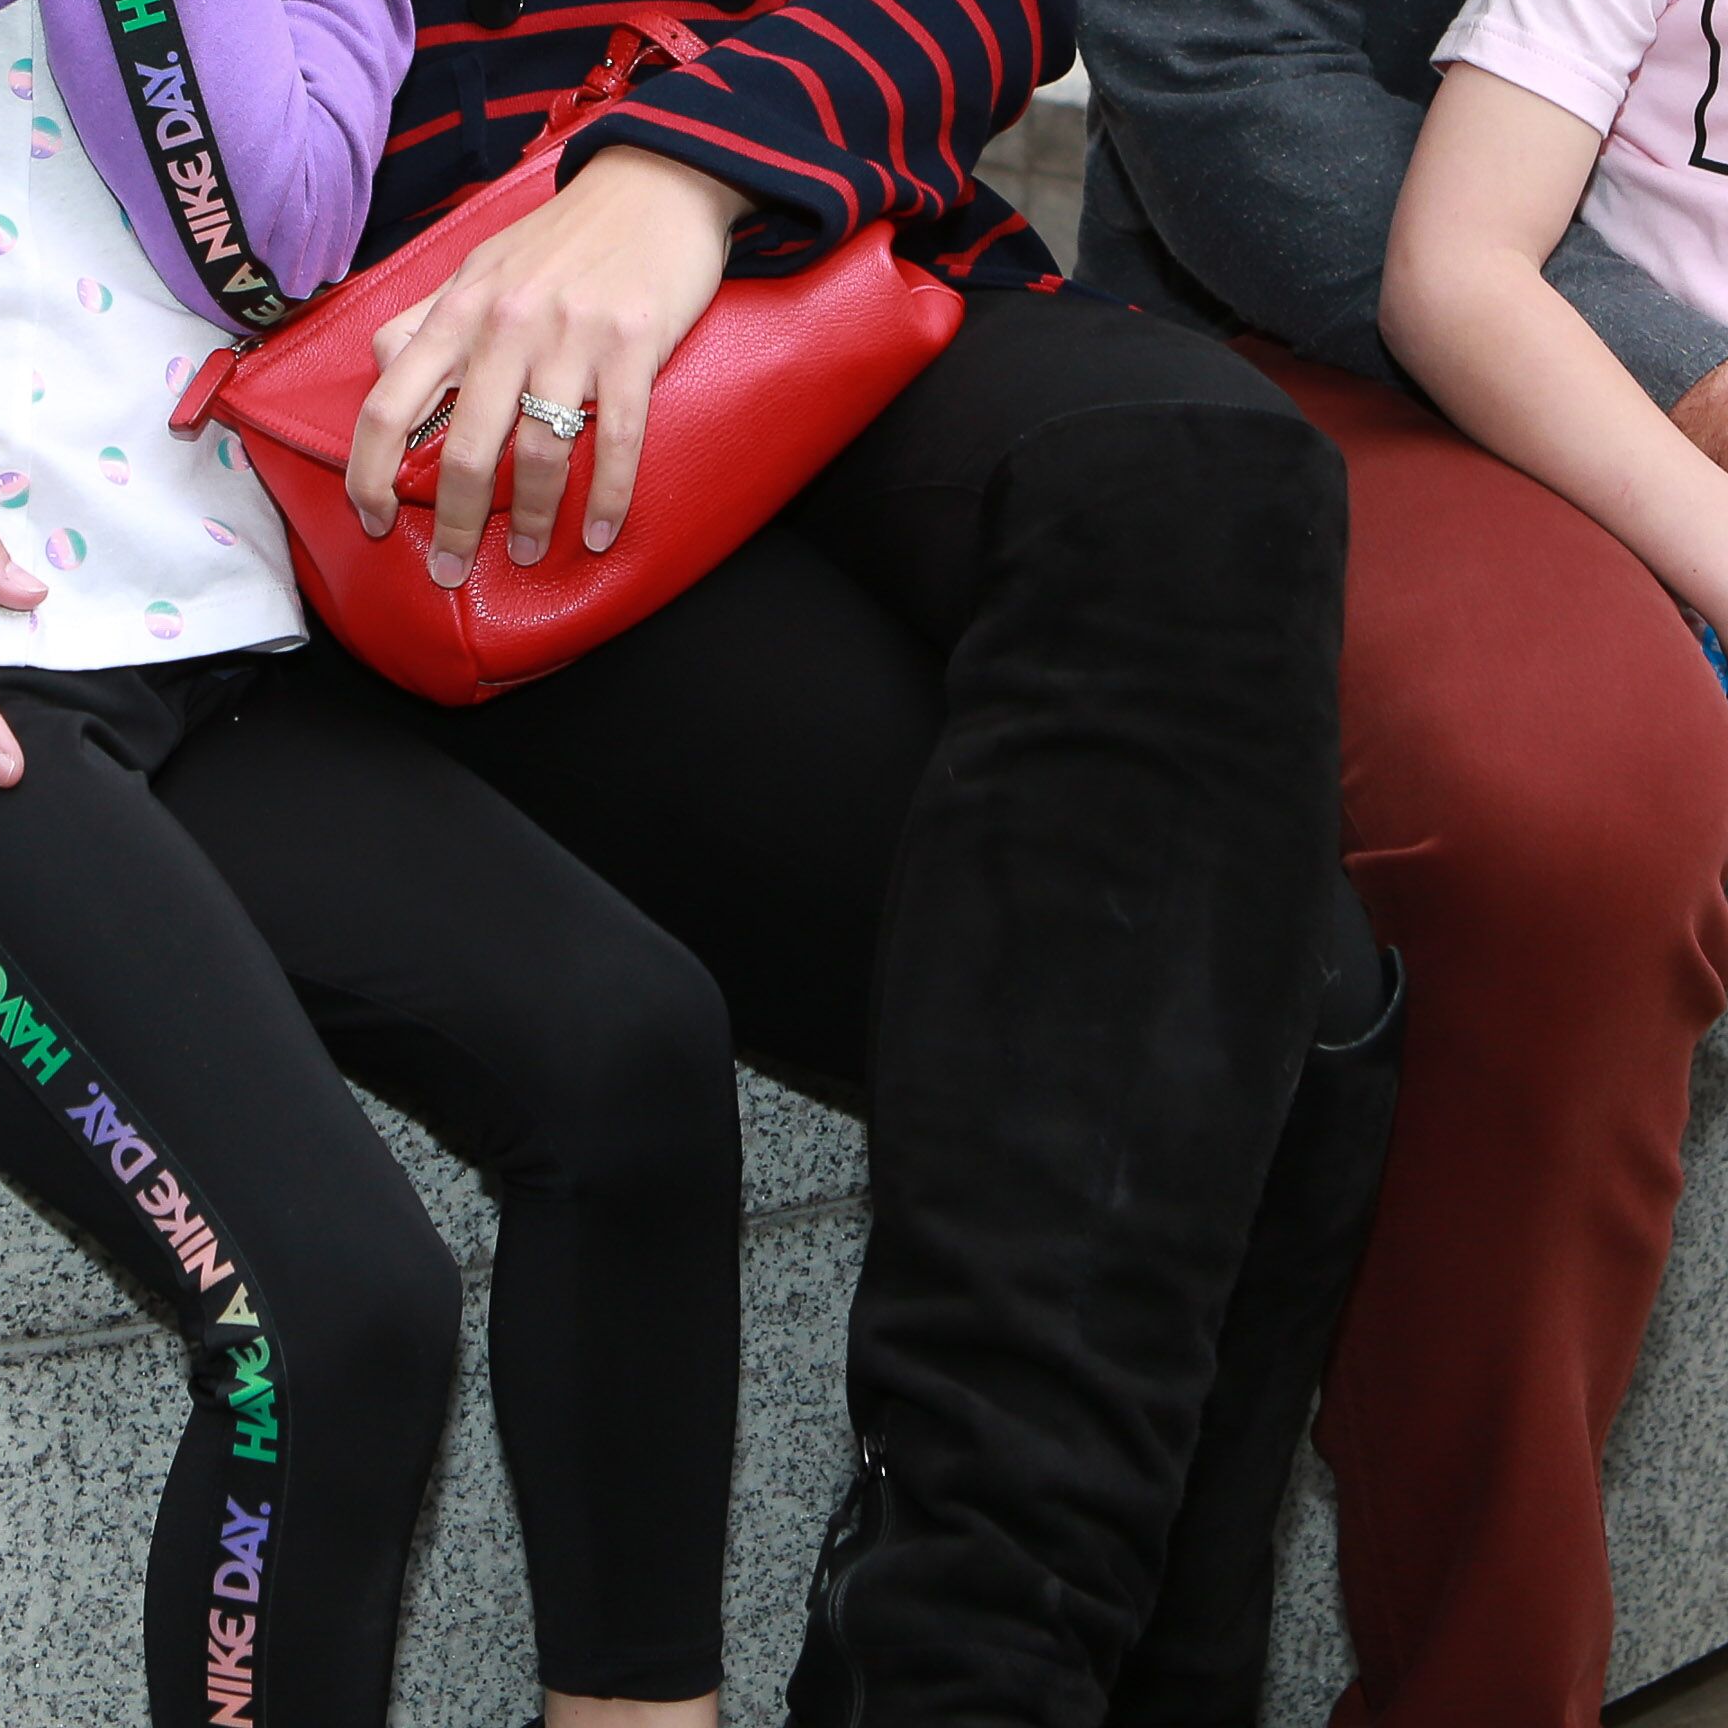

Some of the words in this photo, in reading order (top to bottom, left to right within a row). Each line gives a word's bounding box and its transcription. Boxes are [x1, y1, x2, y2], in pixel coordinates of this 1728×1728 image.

[134, 51, 205, 150] DAY.
[167, 151, 242, 263] NIKE
[223, 262, 268, 293] A
[65, 1083, 158, 1185] DAY.
[135, 1168, 236, 1292] NIKE
[216, 1282, 260, 1328] A
[228, 1335, 278, 1463] HAVE
[213, 1497, 272, 1603] DAY.
[207, 1609, 256, 1728] NIKE
